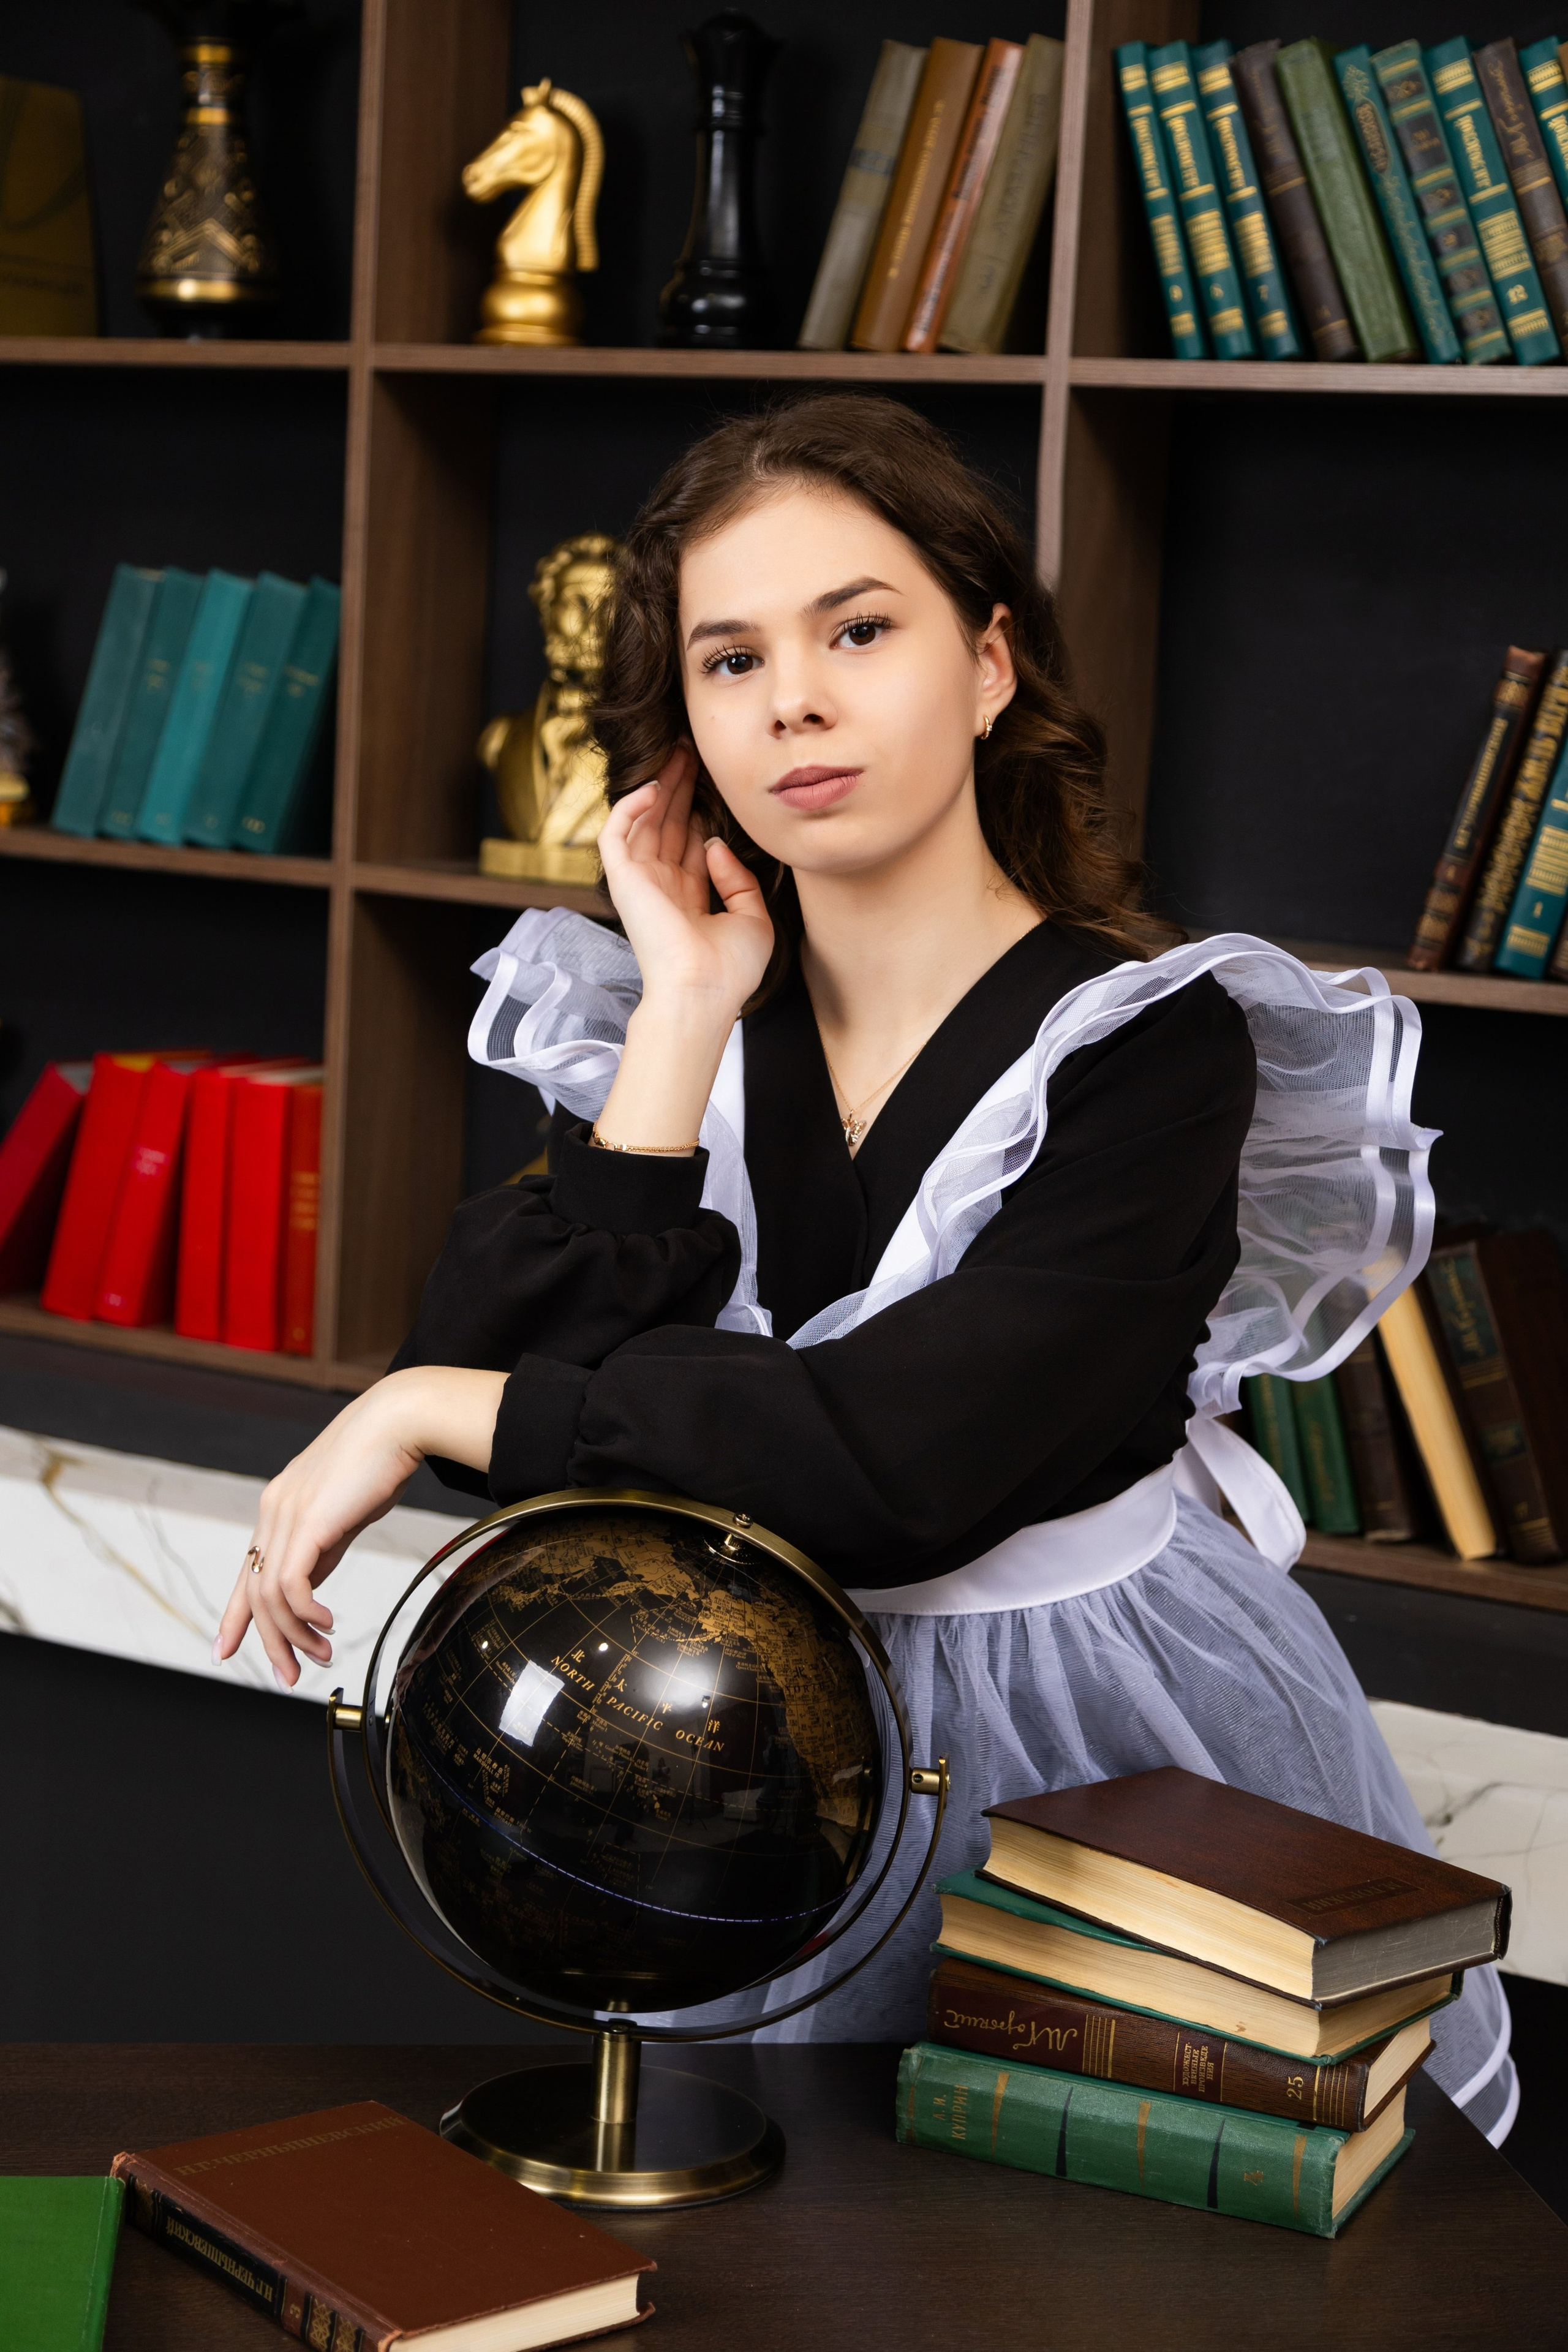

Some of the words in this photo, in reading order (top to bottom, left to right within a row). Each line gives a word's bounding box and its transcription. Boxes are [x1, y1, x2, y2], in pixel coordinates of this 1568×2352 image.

[607, 1653, 628, 1681] International
[551, 1656, 596, 1691] NORTH
[606, 1696, 664, 1731] PACIFIC
[676, 1730, 725, 1752] OCEAN
[471, 1753, 496, 1774] MARSHALL
[1286, 2076, 1303, 2100] 25
[952, 2084, 969, 2139] КУПРИН
[289, 2304, 302, 2319] 3
